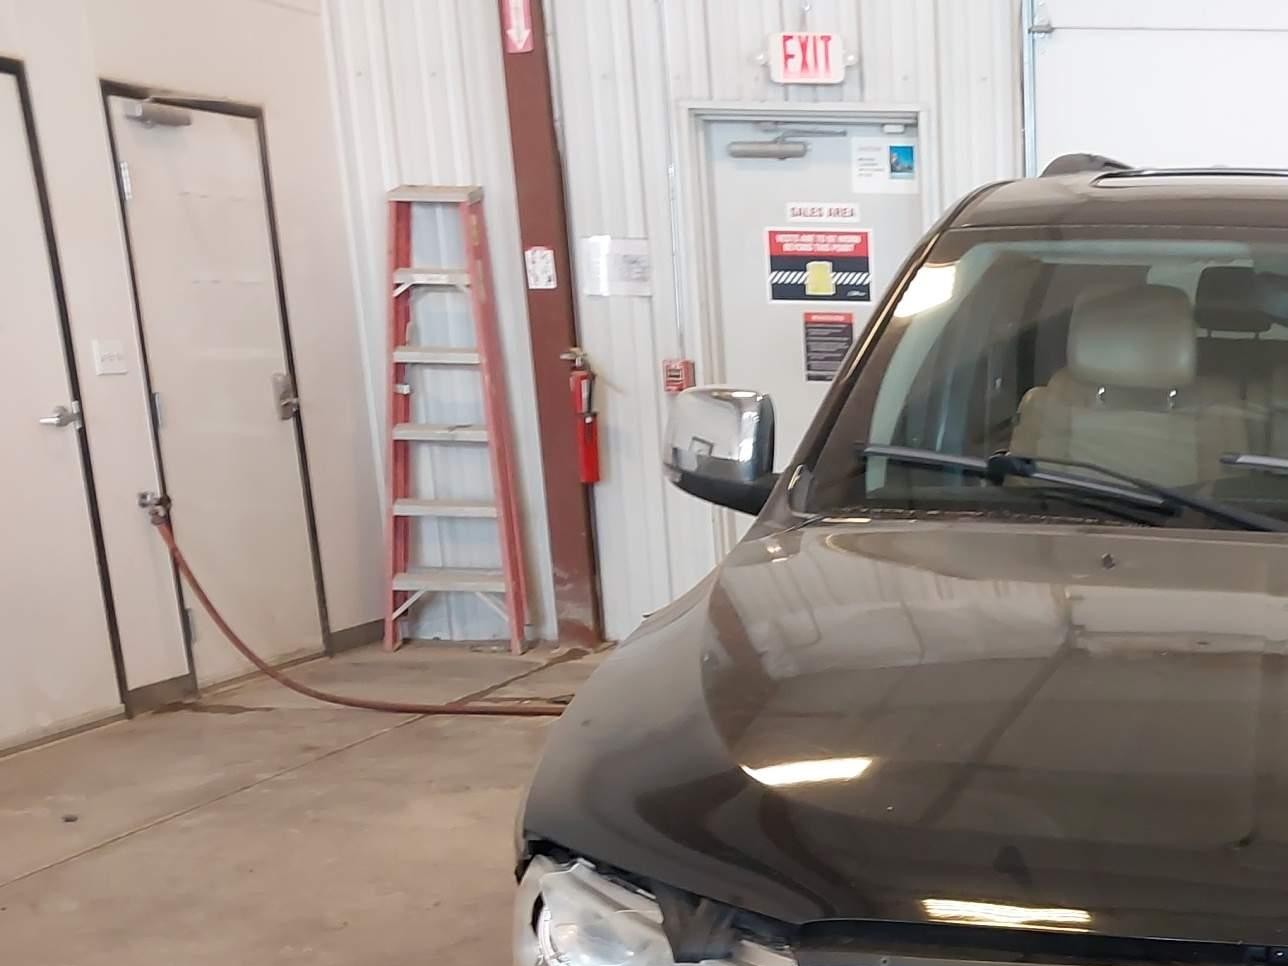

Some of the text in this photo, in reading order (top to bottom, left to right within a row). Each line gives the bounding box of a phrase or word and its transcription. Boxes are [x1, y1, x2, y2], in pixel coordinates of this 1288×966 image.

[782, 34, 832, 76] EXIT
[790, 206, 856, 219] SALES AREA
